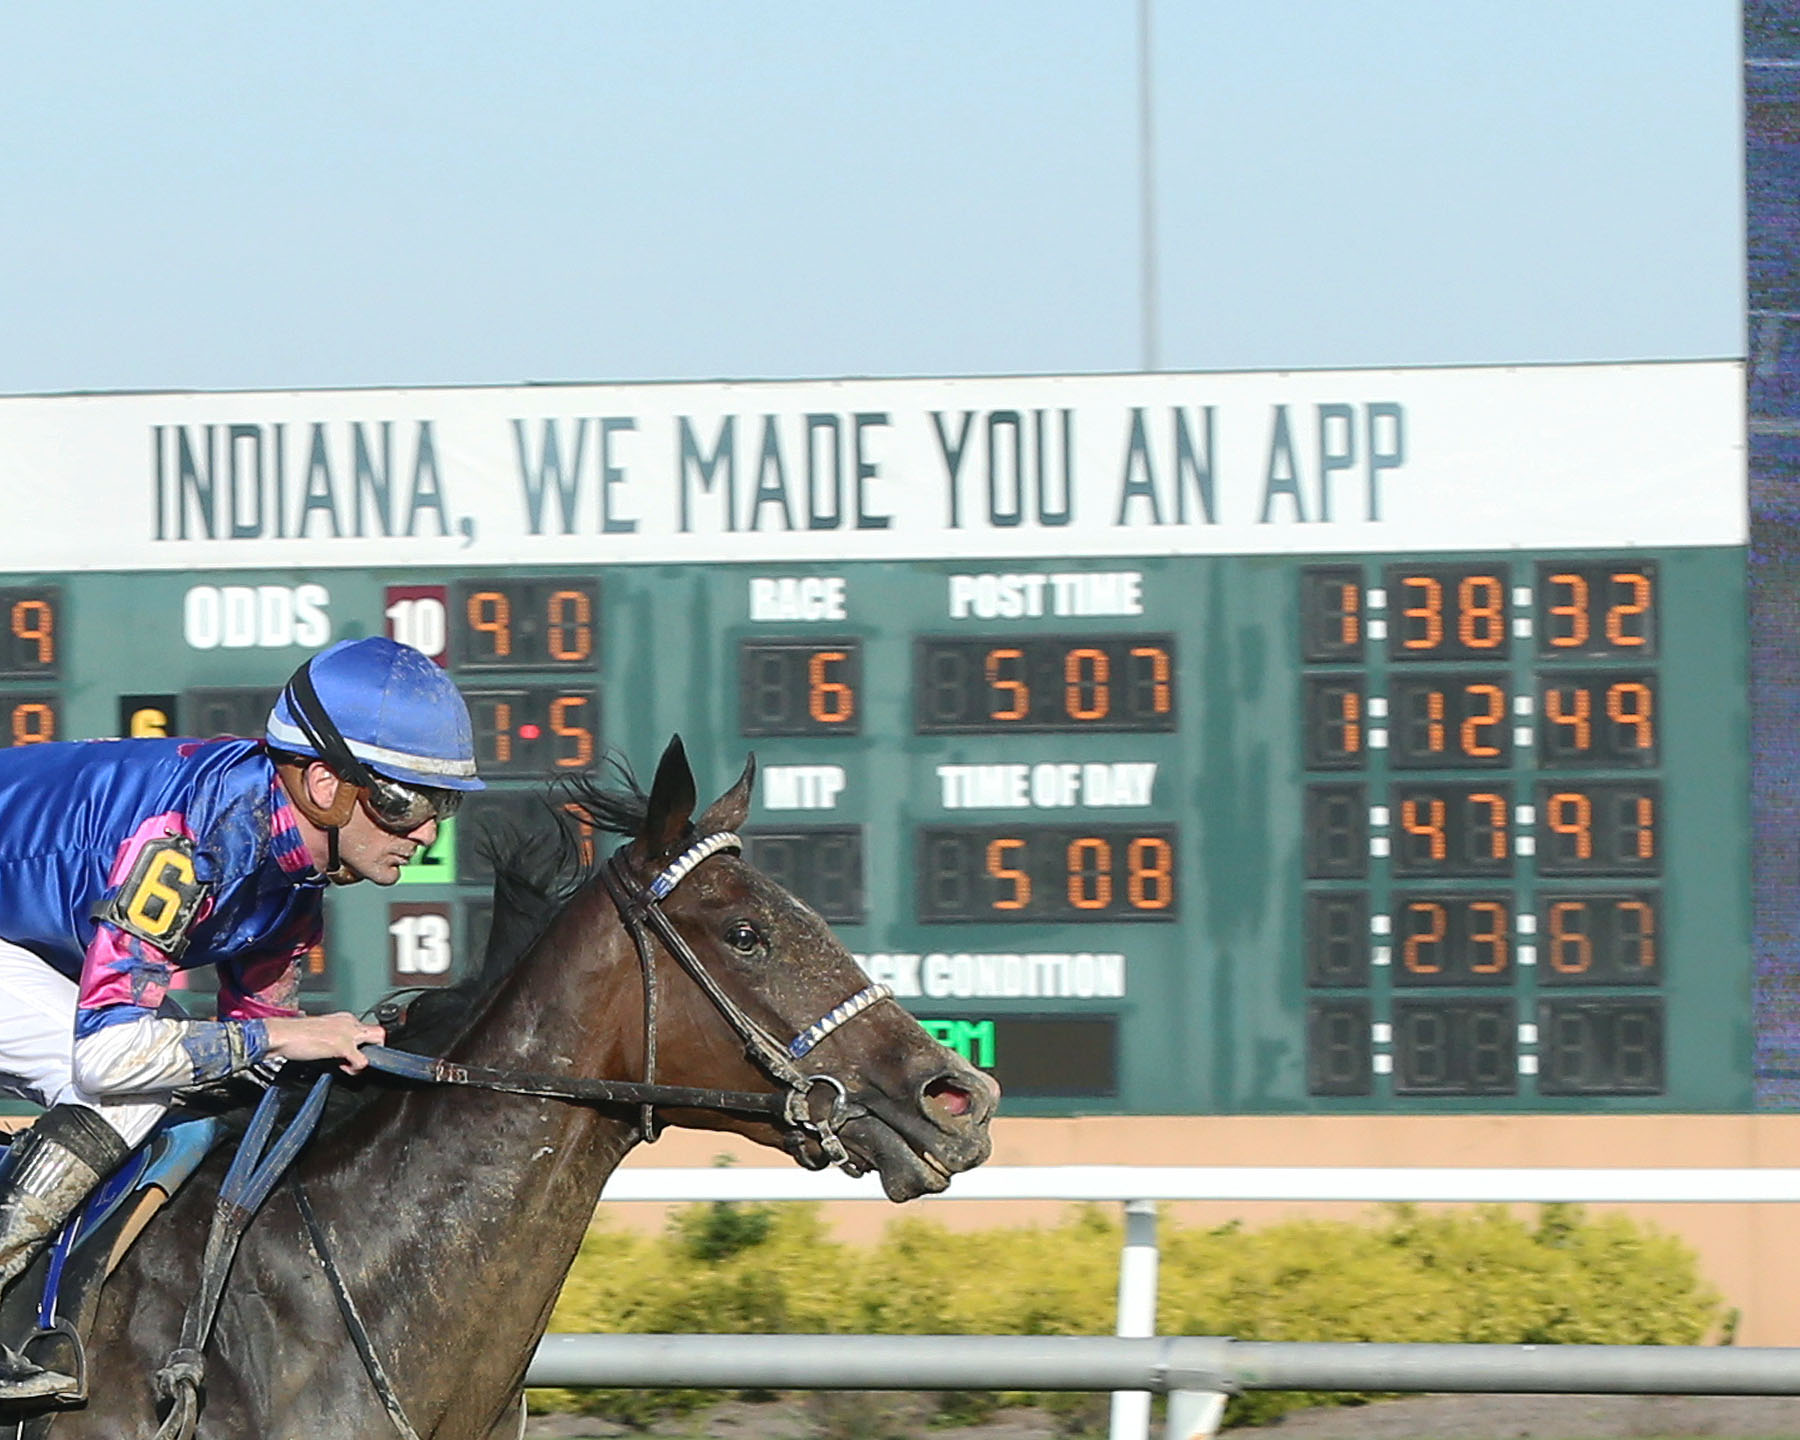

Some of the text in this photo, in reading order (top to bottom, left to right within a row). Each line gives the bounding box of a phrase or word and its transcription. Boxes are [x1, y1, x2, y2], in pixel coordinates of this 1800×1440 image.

[149, 401, 1406, 548] INDIANA, WE MADE YOU AN APP
[185, 584, 331, 649] ODDS
[749, 577, 848, 622] RACE
[948, 571, 1144, 619] POST TIME
[385, 597, 446, 659] 10
[808, 651, 855, 723] 6
[762, 764, 846, 810] MTP
[936, 762, 1158, 809] TIME OF DAY
[126, 848, 196, 937] 6
[389, 913, 451, 975] 13
[922, 952, 1127, 998] CONDITION
